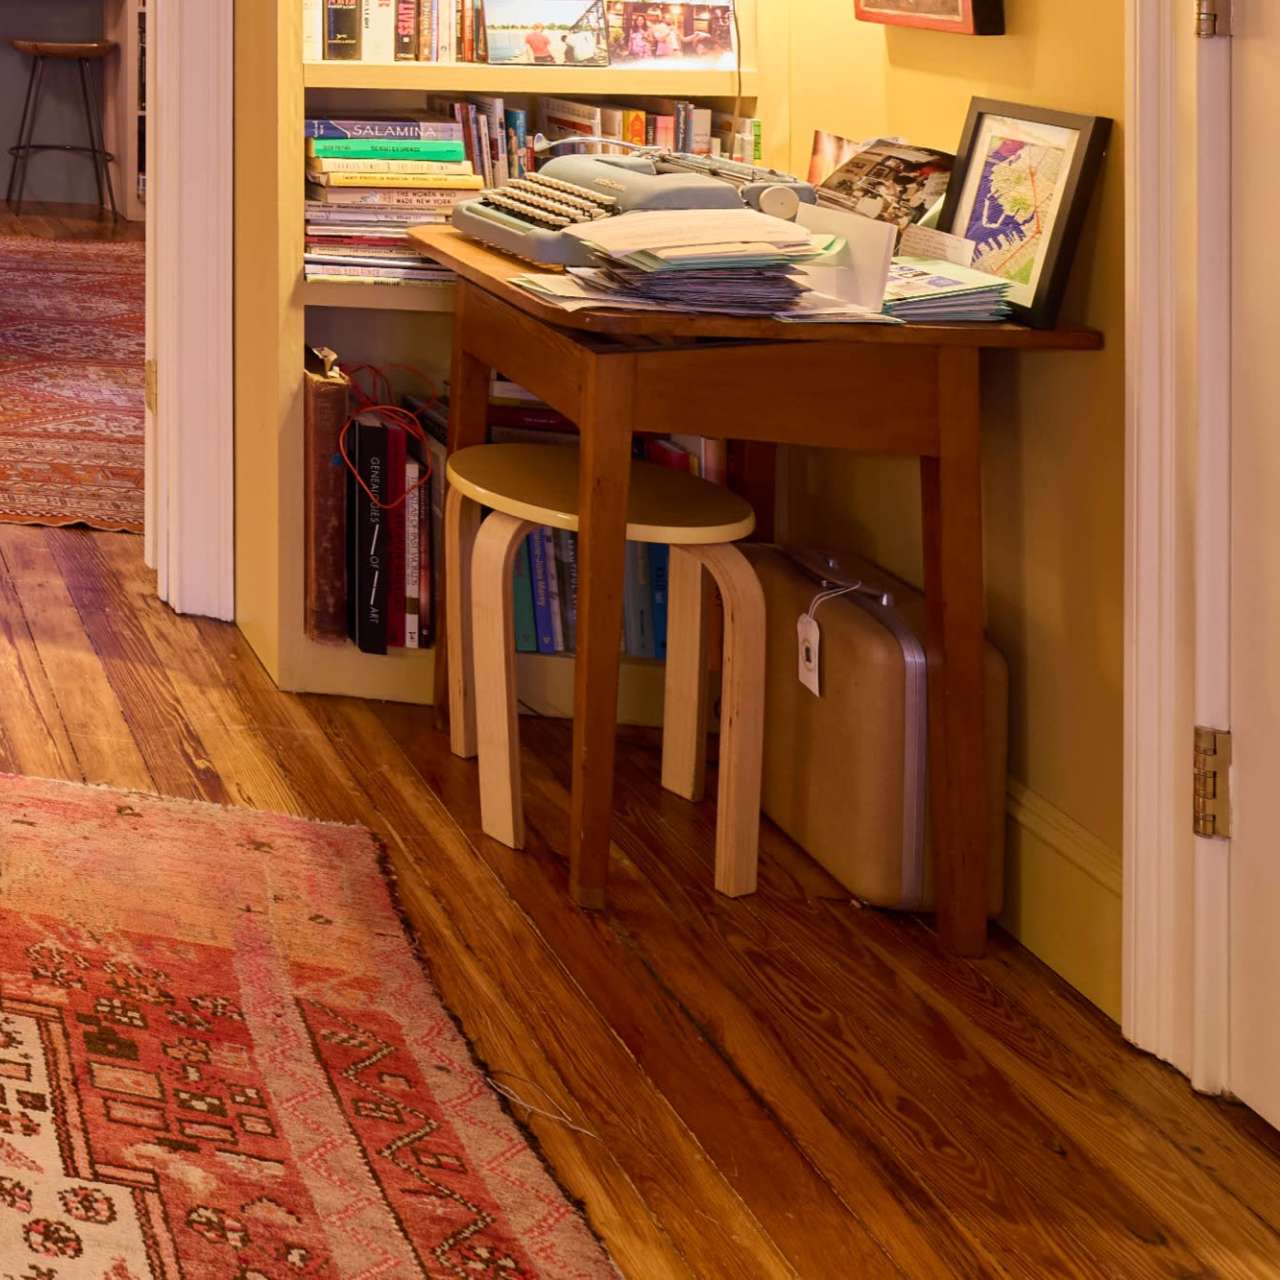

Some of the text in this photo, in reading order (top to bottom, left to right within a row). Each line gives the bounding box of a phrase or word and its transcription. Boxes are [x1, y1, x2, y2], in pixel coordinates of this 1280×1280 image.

[399, 3, 415, 35] LIVES
[352, 125, 437, 137] SALAMINA
[369, 606, 379, 624] ART
